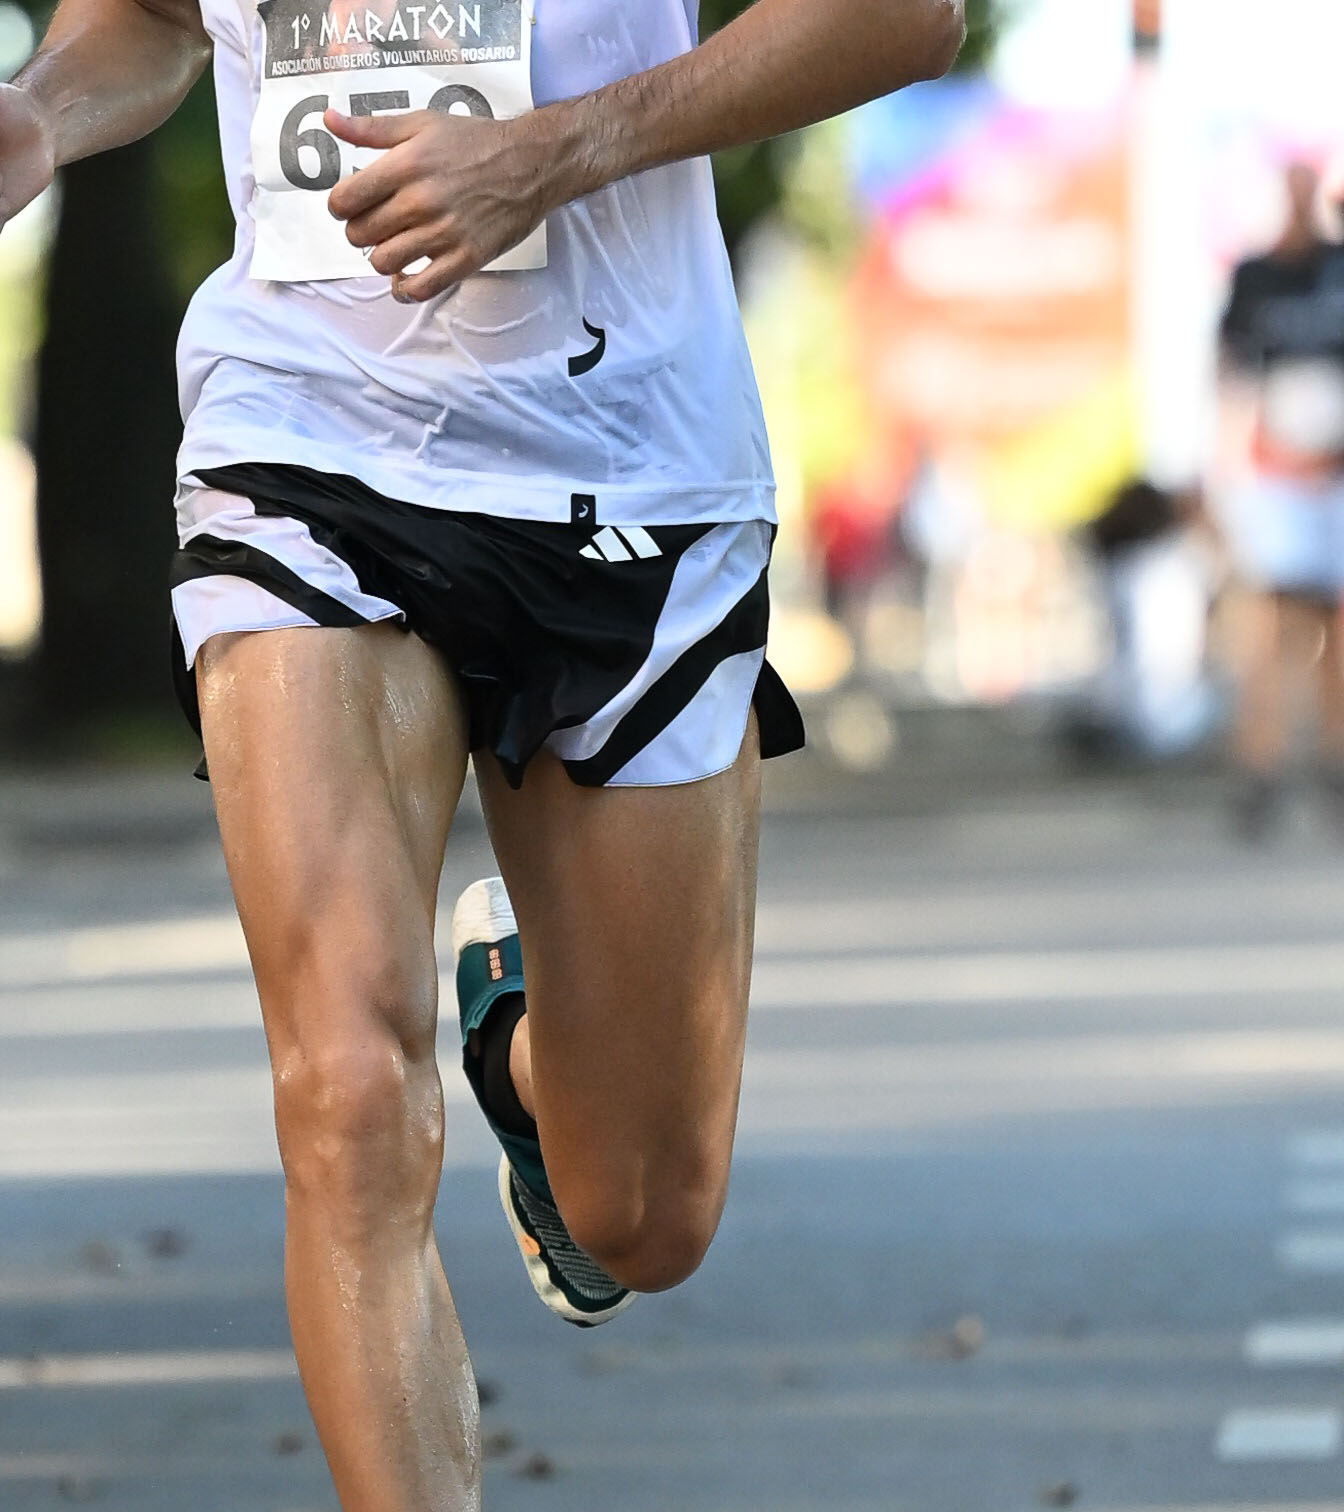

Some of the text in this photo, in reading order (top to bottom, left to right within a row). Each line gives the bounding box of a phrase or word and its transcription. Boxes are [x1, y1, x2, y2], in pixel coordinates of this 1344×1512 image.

[271, 45, 516, 76] ASOCIACIÓN BOMBEROS VOLUNTARIOS ROSARIO
